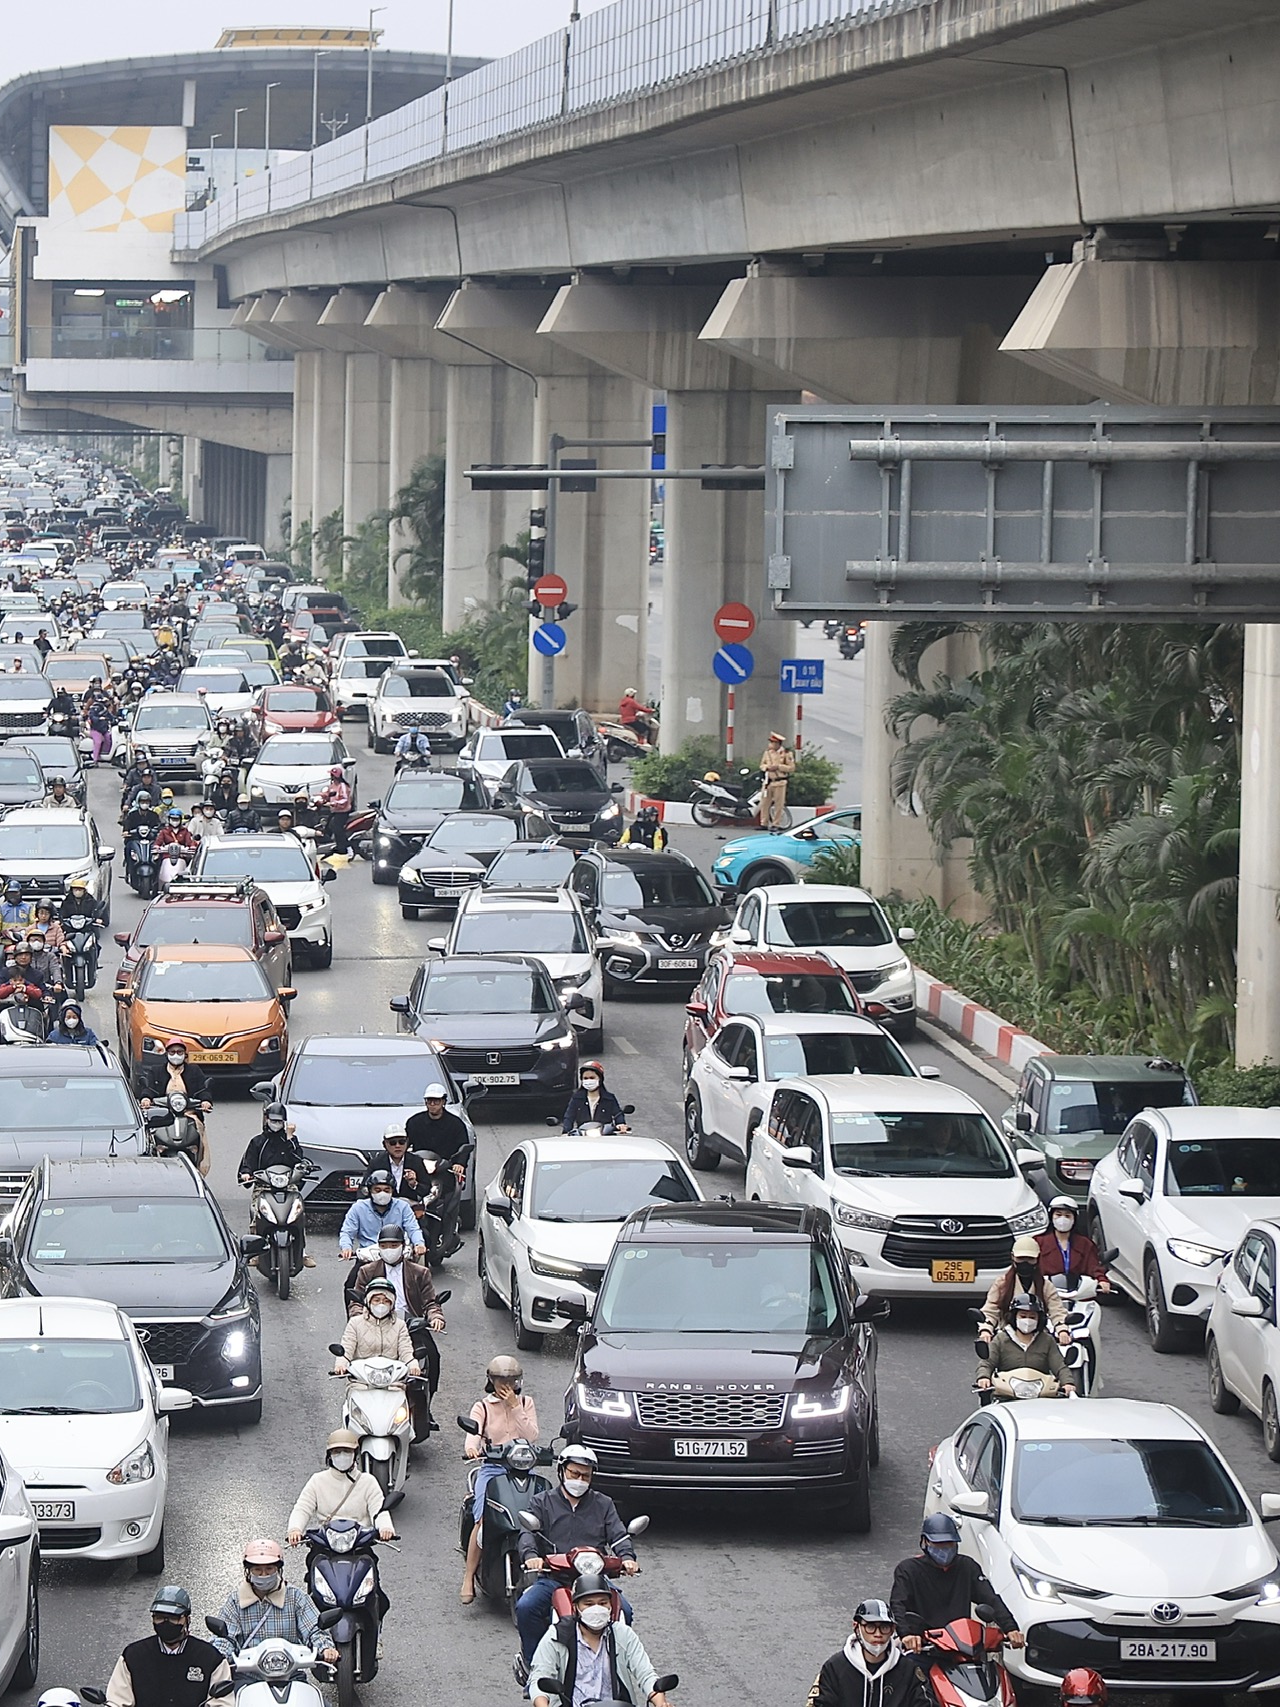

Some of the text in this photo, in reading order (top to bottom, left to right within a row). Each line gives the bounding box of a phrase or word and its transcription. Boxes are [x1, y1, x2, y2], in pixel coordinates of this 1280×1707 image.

[944, 1261, 962, 1270] 29E
[936, 1270, 970, 1281] 056.37
[676, 1441, 745, 1455] 51G-771.52
[1129, 1642, 1208, 1657] 28A-217.90
